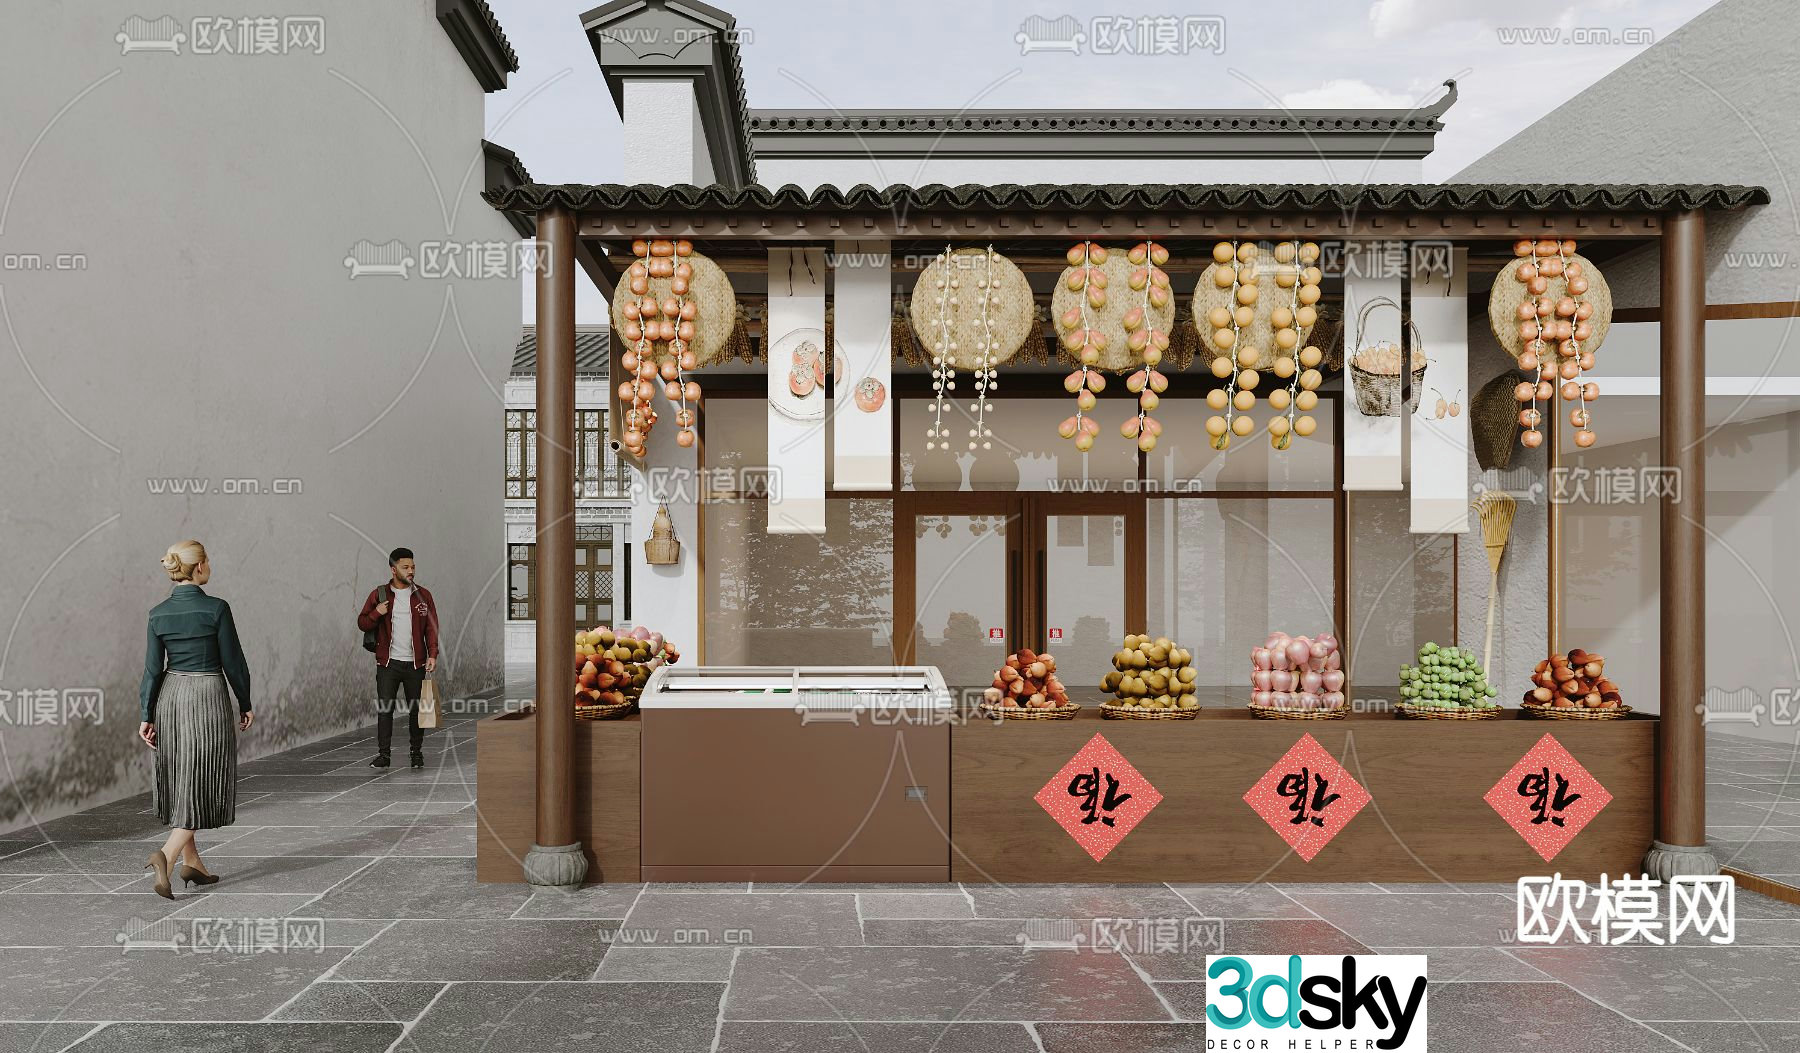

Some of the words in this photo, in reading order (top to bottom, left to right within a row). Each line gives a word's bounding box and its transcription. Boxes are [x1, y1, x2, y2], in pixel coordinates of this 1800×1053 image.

[1068, 767, 1132, 828] 福
[1277, 767, 1341, 828] 福
[1517, 767, 1582, 828] 福
